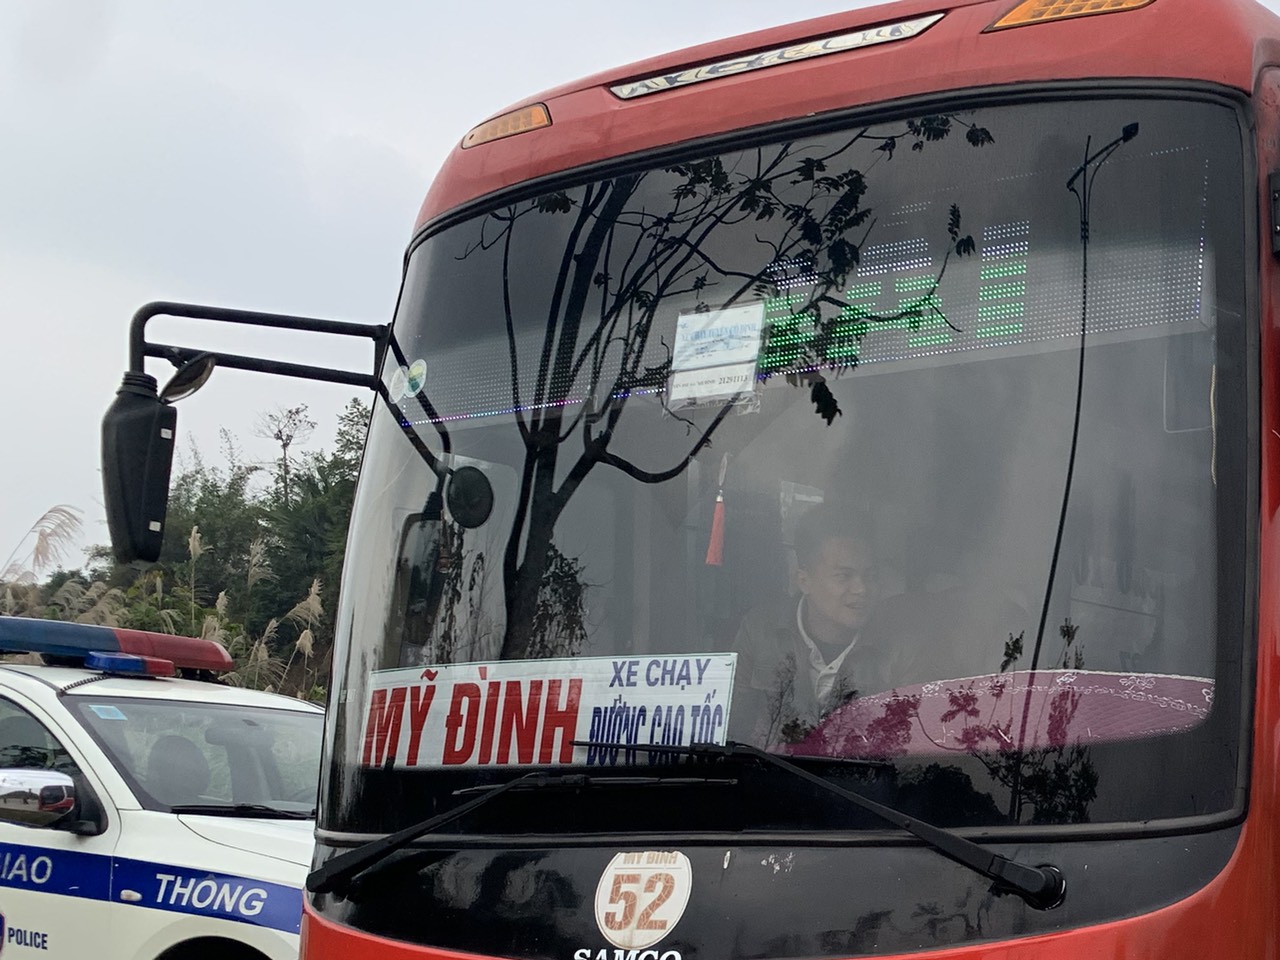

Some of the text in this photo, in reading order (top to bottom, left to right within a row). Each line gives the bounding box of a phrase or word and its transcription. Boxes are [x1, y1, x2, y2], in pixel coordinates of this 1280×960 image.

[609, 658, 711, 691] XE CHẠY
[362, 666, 583, 769] MỸ ĐÌNH
[0, 852, 53, 884] IAO
[604, 872, 676, 931] 52
[7, 927, 48, 951] POLICE
